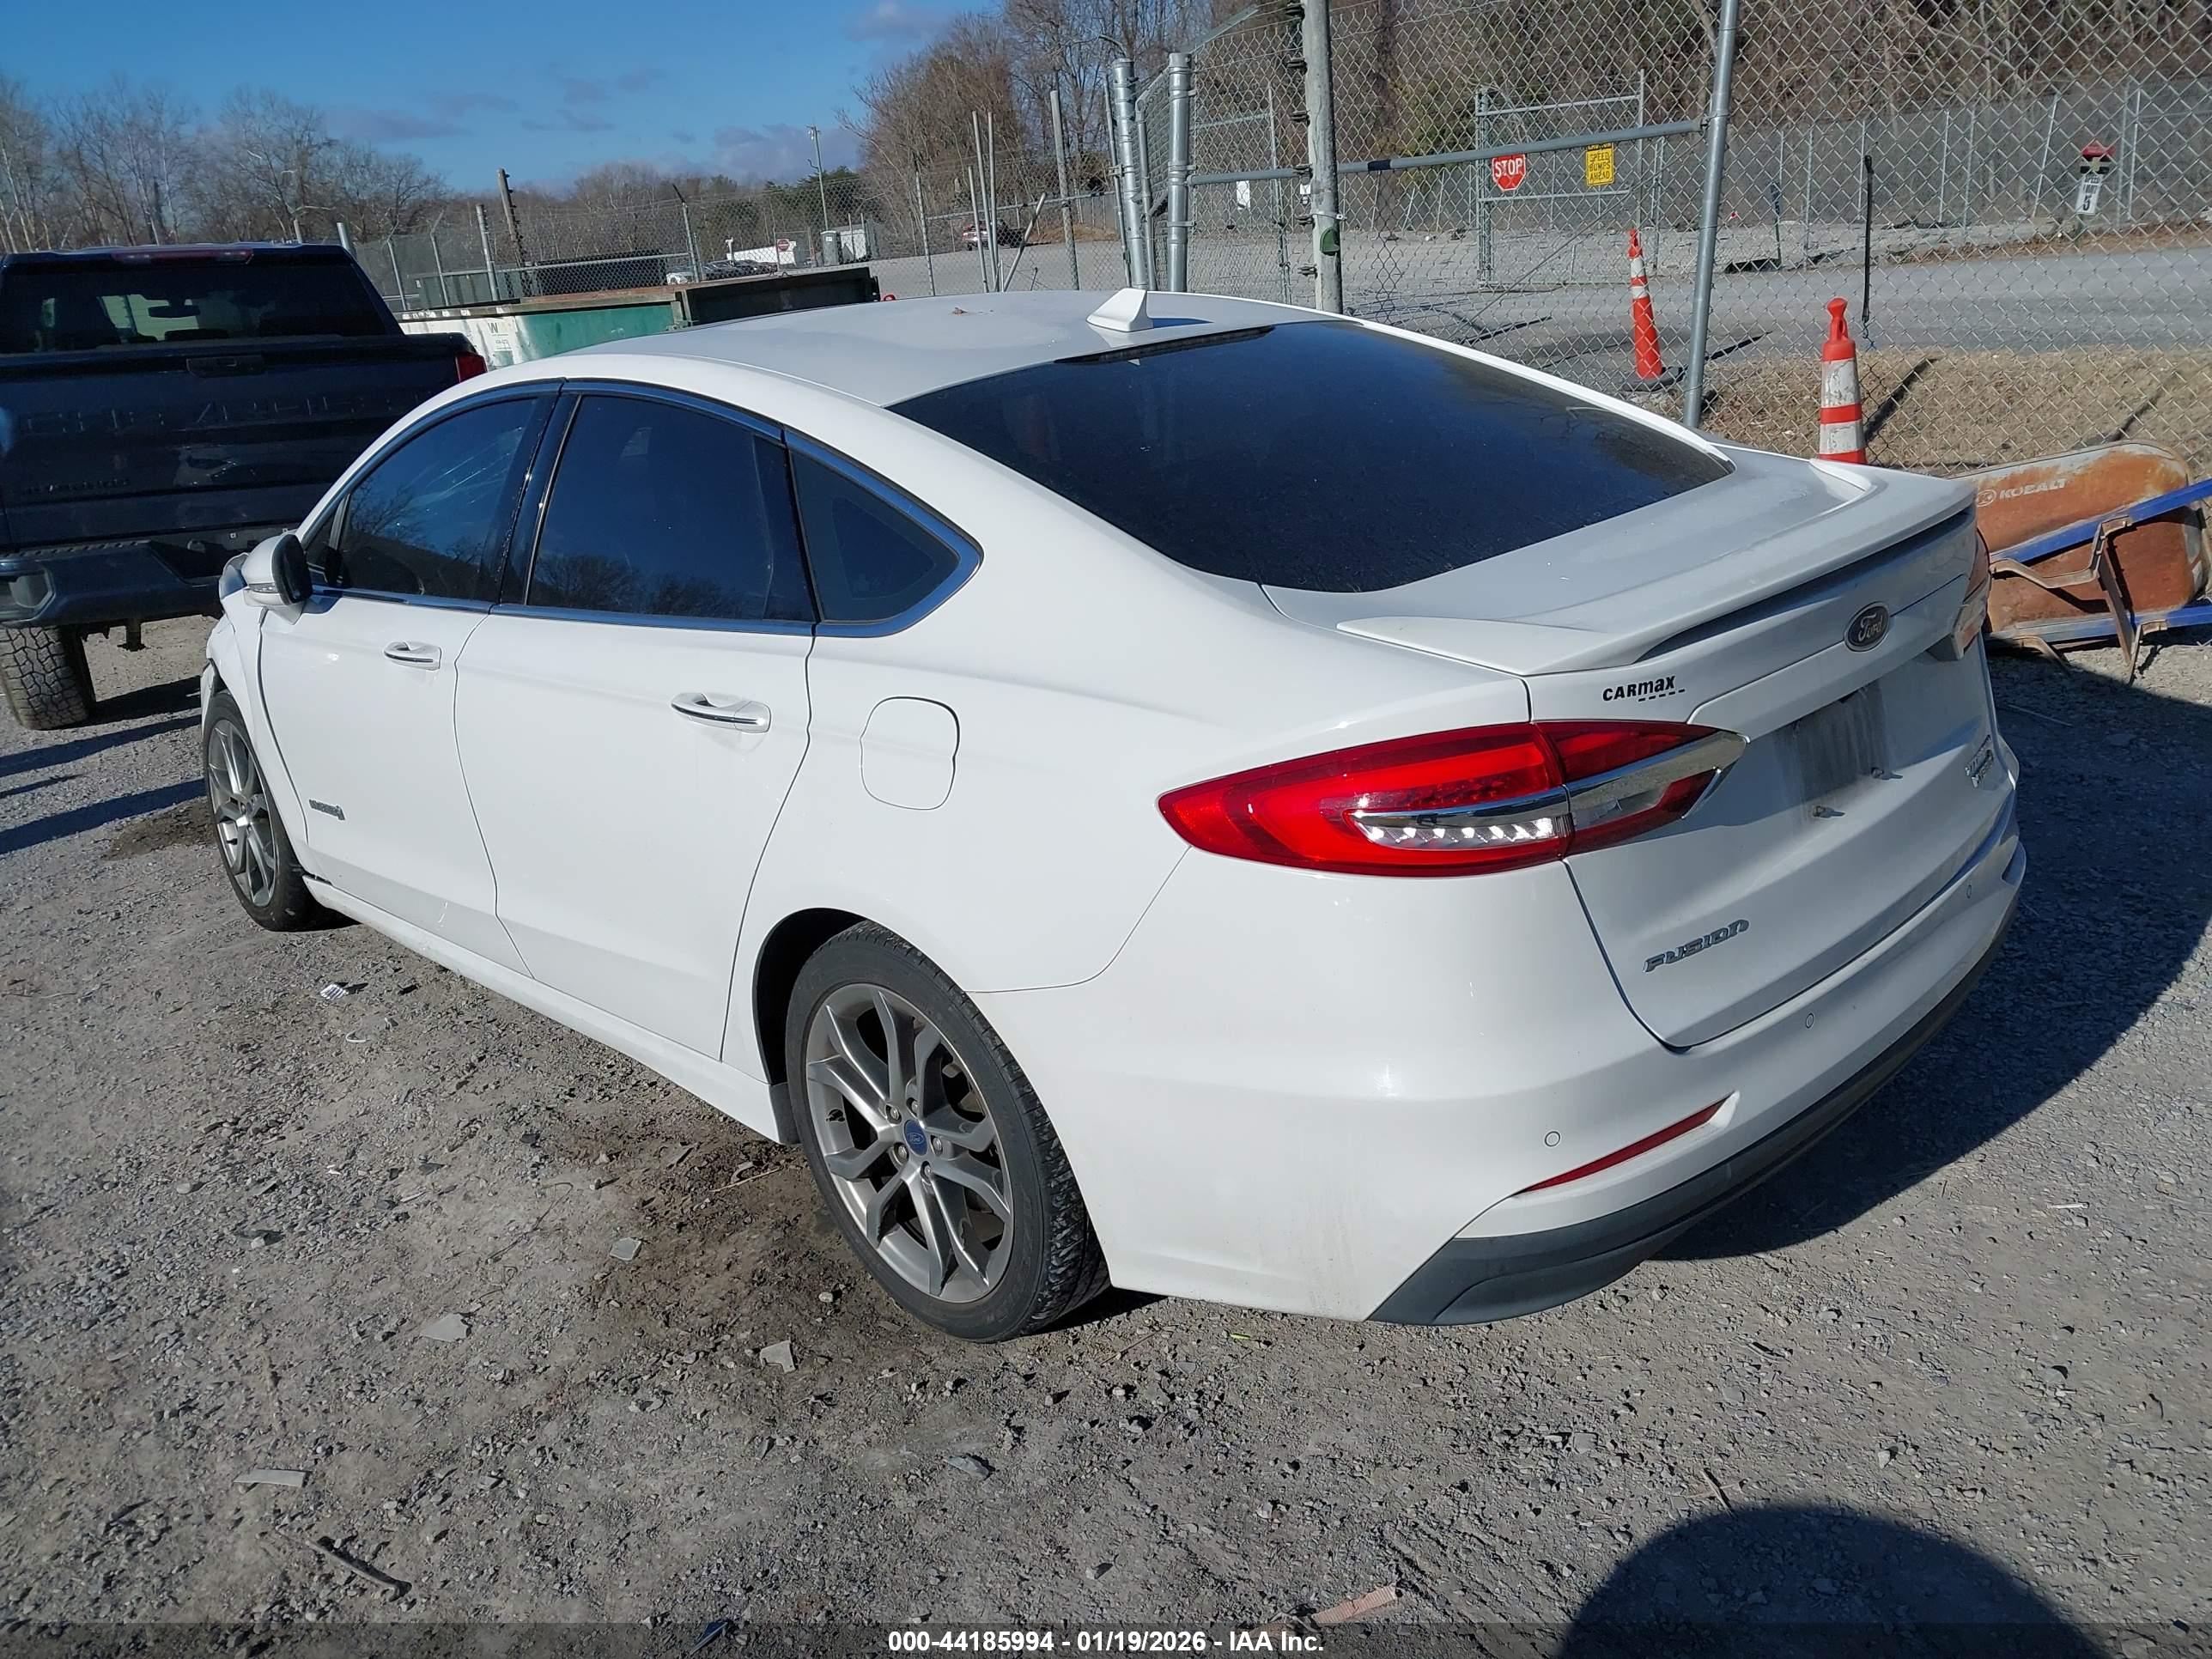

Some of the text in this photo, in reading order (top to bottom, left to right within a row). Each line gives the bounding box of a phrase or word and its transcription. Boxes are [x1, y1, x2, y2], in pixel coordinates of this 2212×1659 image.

[1589, 152, 1610, 161] SPEED
[1494, 159, 1523, 178] STOP
[1589, 161, 1611, 172] BUMPS
[2082, 194, 2093, 211] 5
[1643, 919, 1750, 973] FUSION
